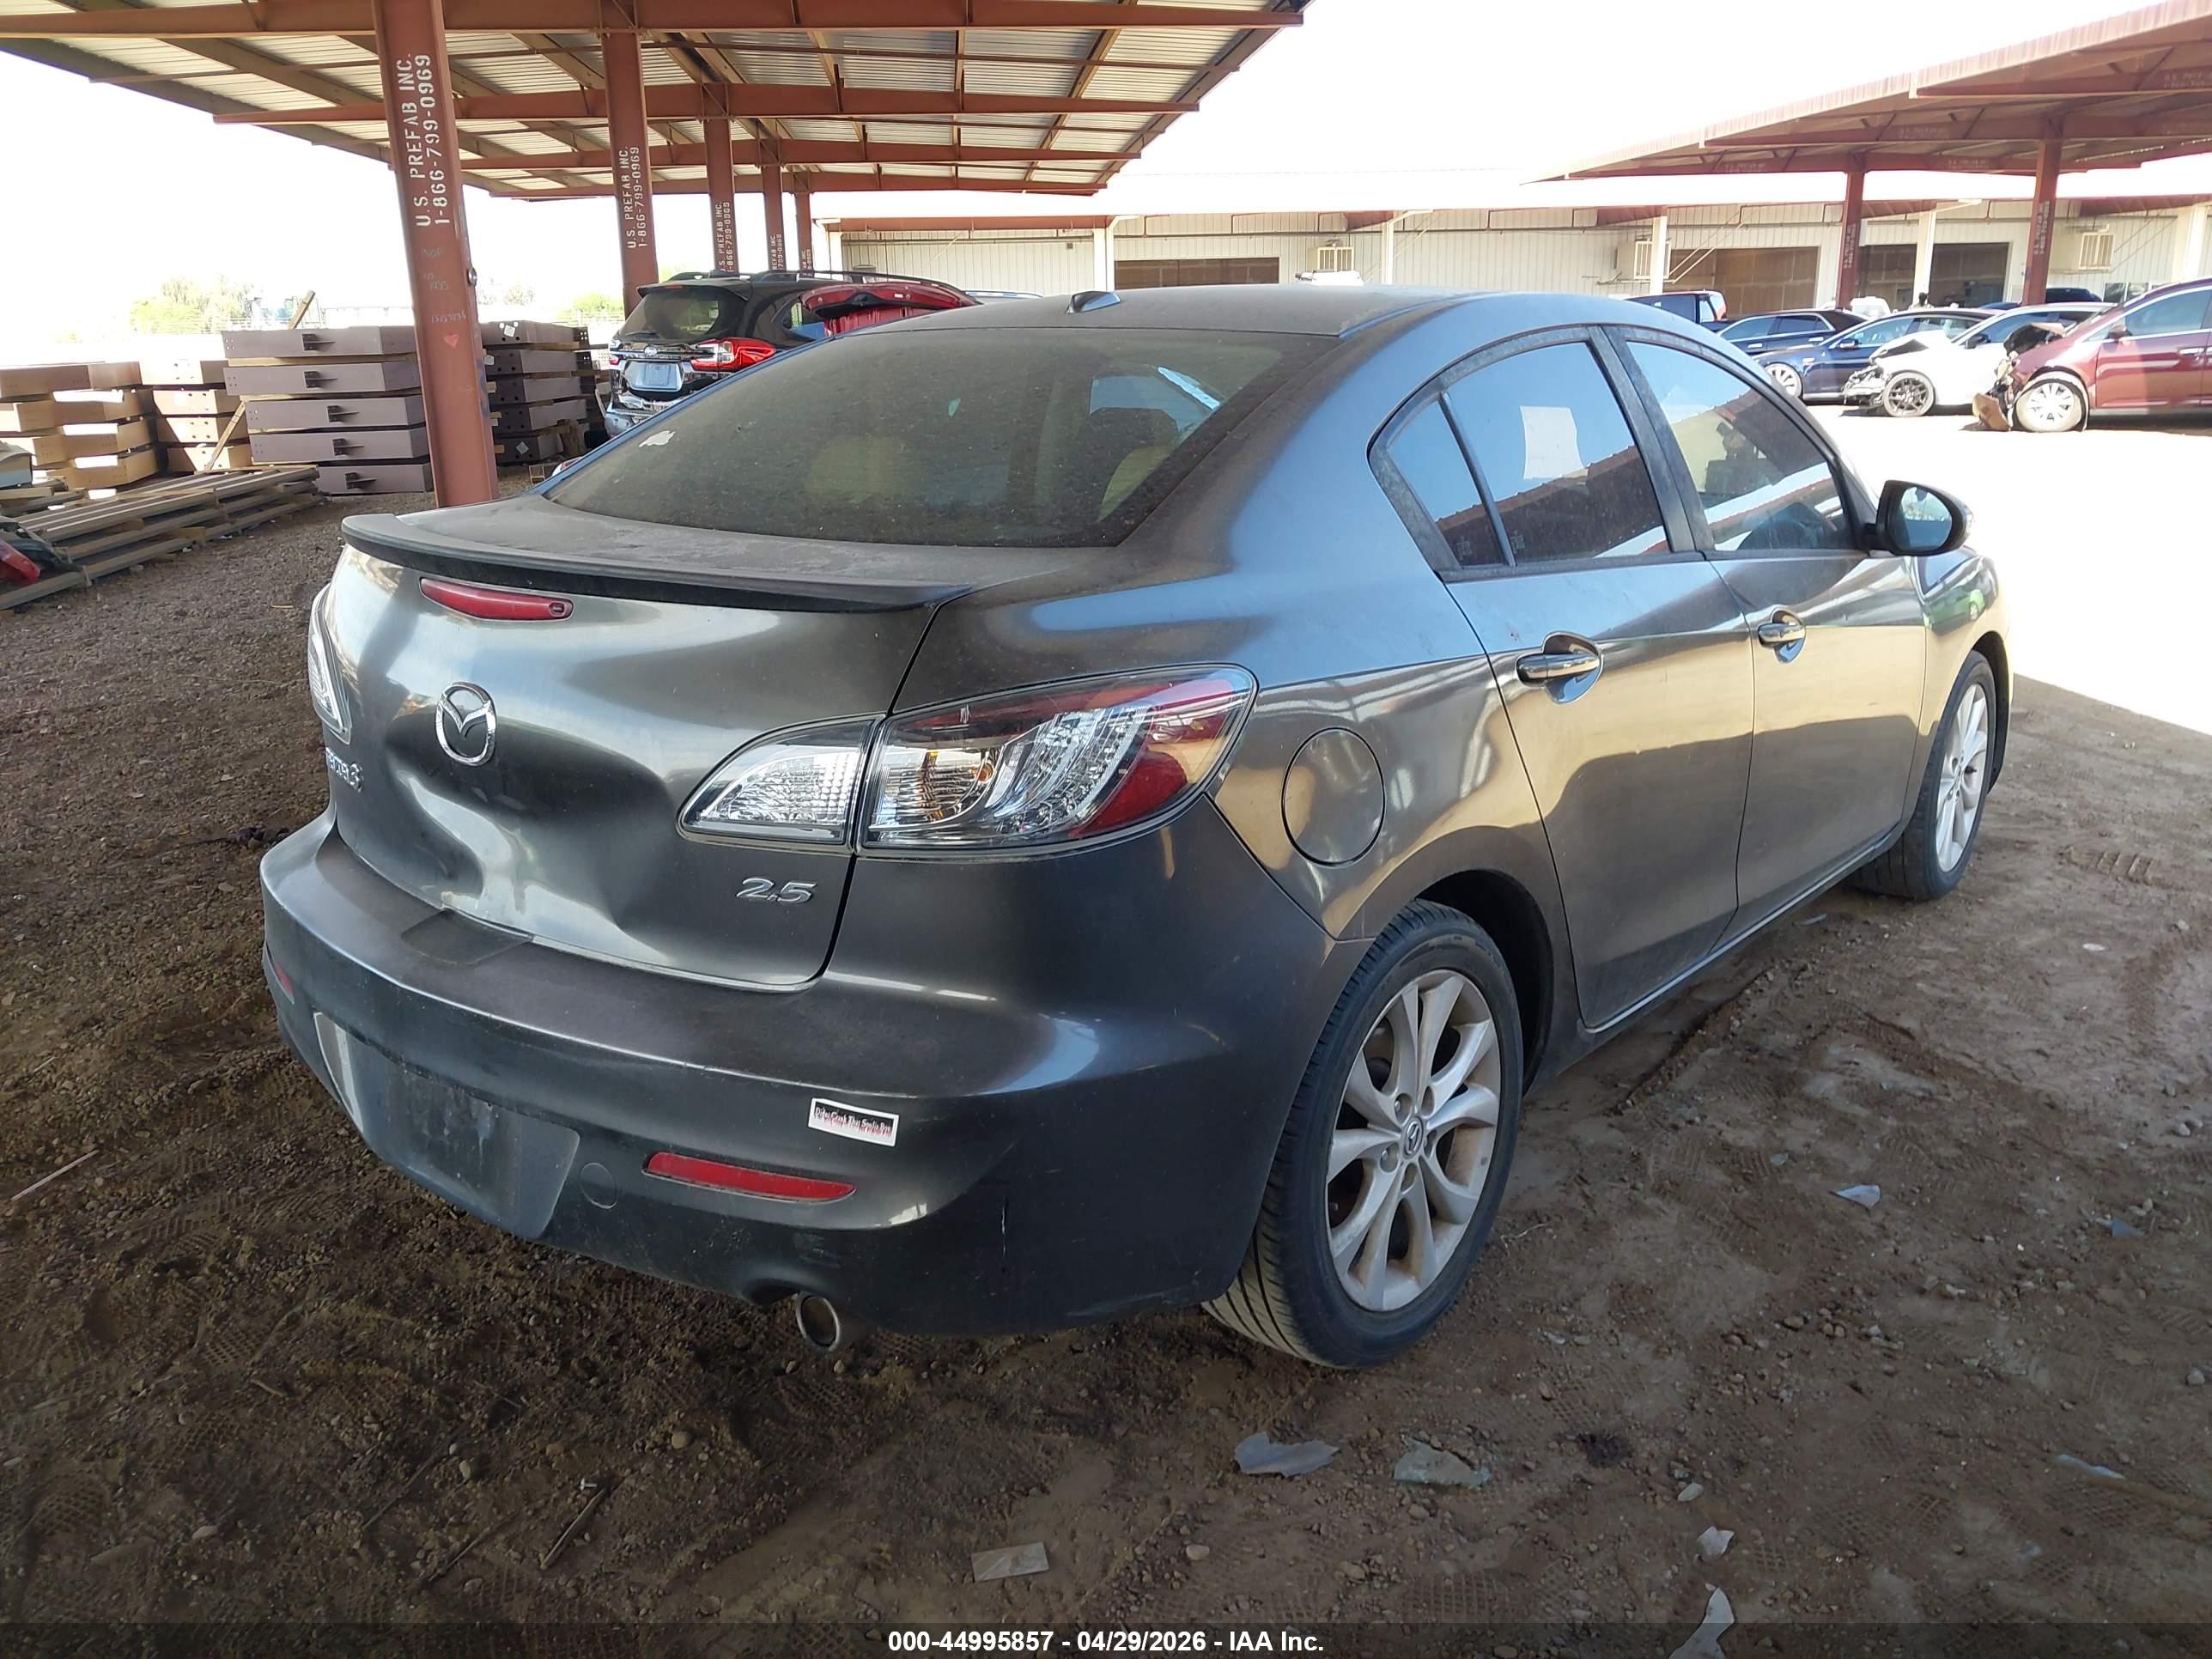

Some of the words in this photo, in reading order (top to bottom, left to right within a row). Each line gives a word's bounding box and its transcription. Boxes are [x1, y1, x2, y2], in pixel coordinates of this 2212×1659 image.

[397, 54, 415, 91] INC.
[401, 101, 426, 179] PREFAB
[414, 54, 450, 224] 1-866-799-0969
[619, 146, 629, 168] INC.
[412, 191, 431, 227] U.S.
[622, 174, 635, 220] PREFAB
[629, 147, 647, 247] 1-866-799-0969
[626, 227, 636, 248] U.S.
[716, 222, 725, 254] PREFAB
[736, 878, 817, 904] 2.5
